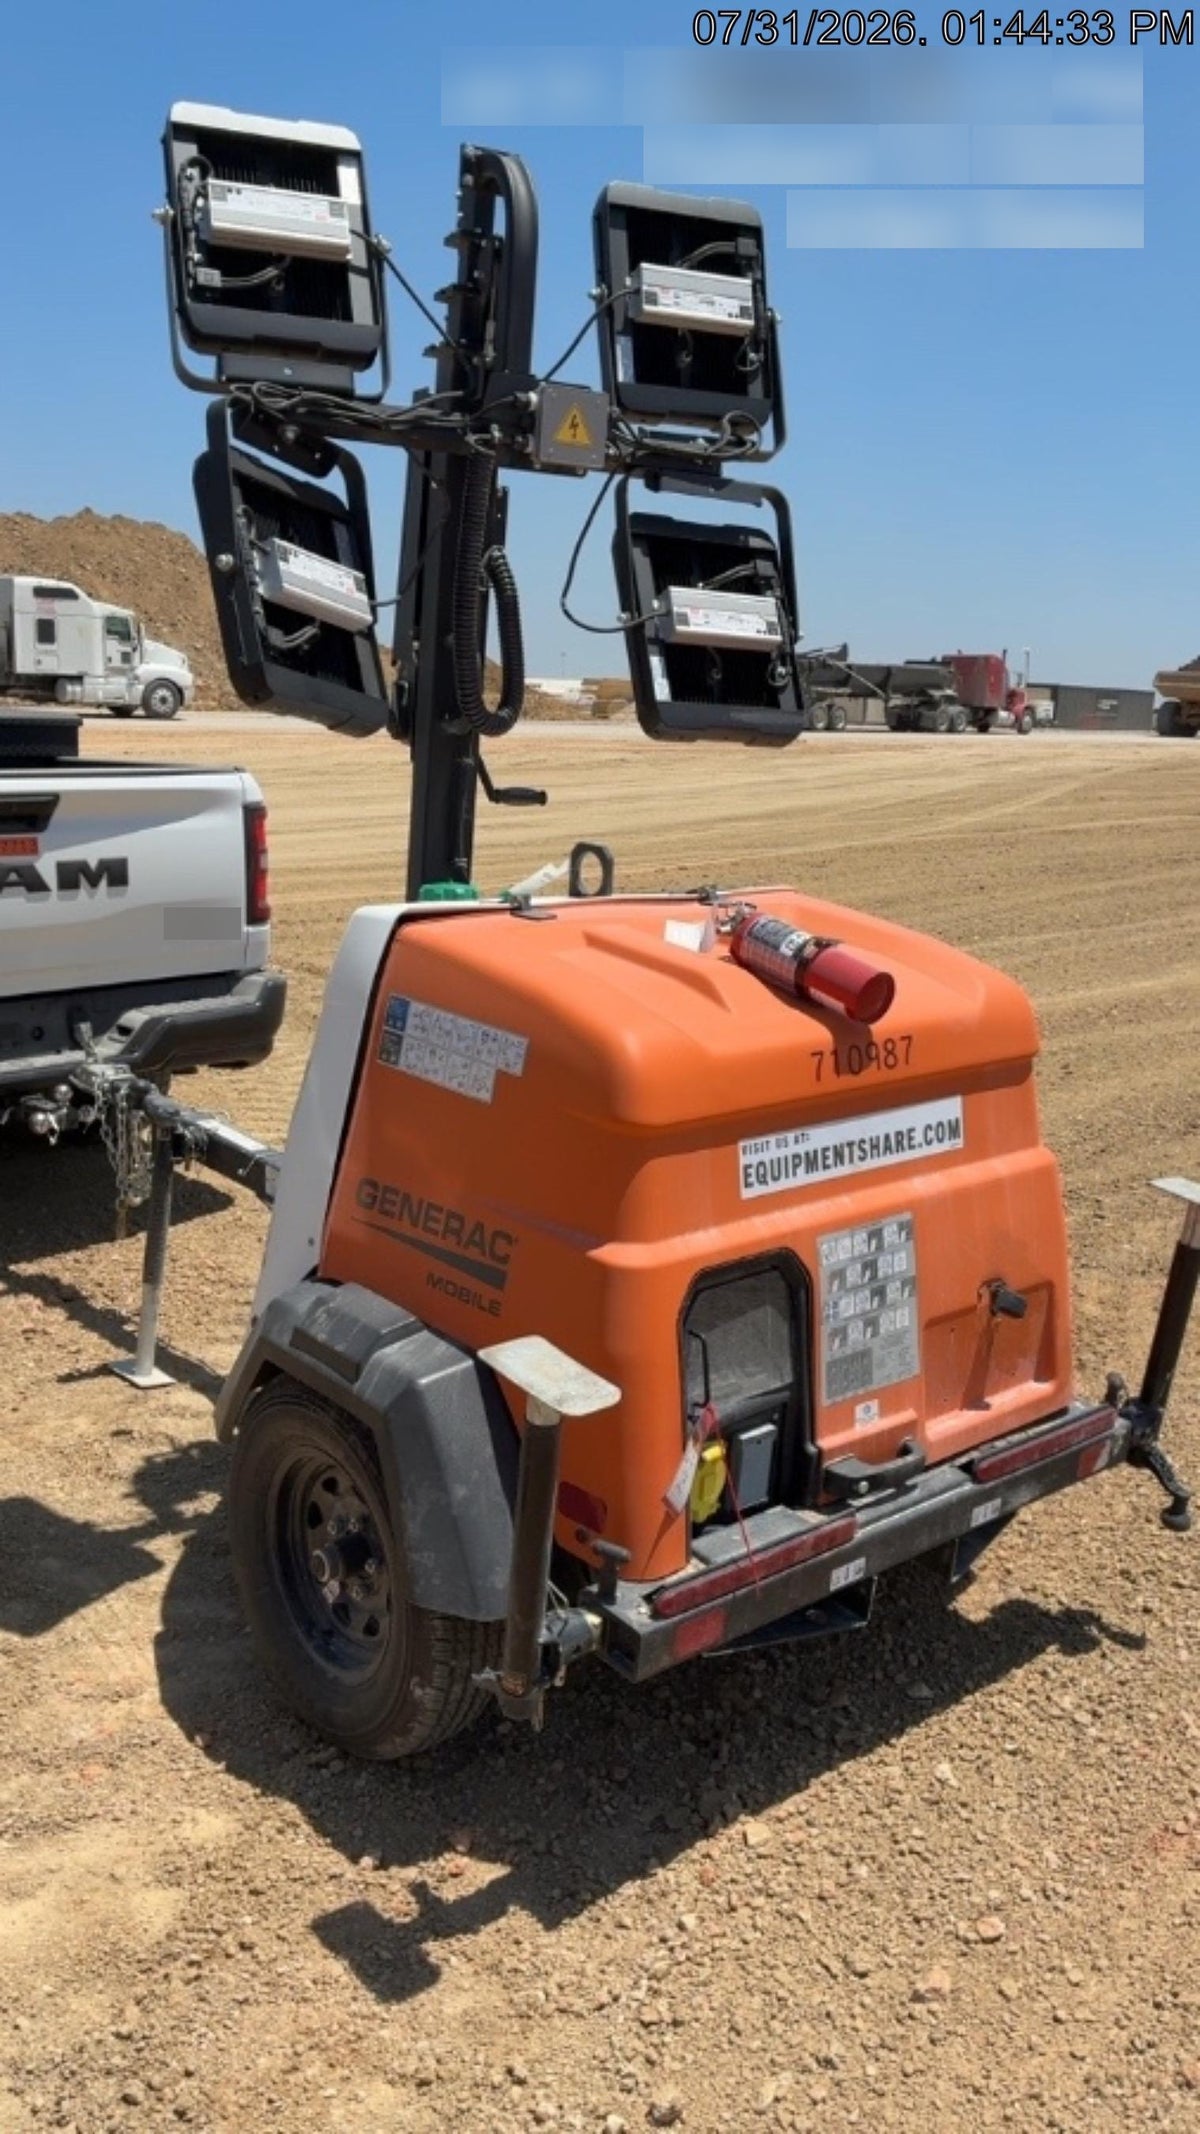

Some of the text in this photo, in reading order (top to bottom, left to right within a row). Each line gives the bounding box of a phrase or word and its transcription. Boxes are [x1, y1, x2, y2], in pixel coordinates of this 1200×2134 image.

[811, 1036, 912, 1082] 710987
[742, 1140, 770, 1155] VISIT
[775, 1135, 788, 1149] US
[743, 1117, 960, 1188] EQUIPMENTSHARE.COM
[356, 1177, 513, 1265] GENERAC
[427, 1272, 502, 1317] MOBILE
